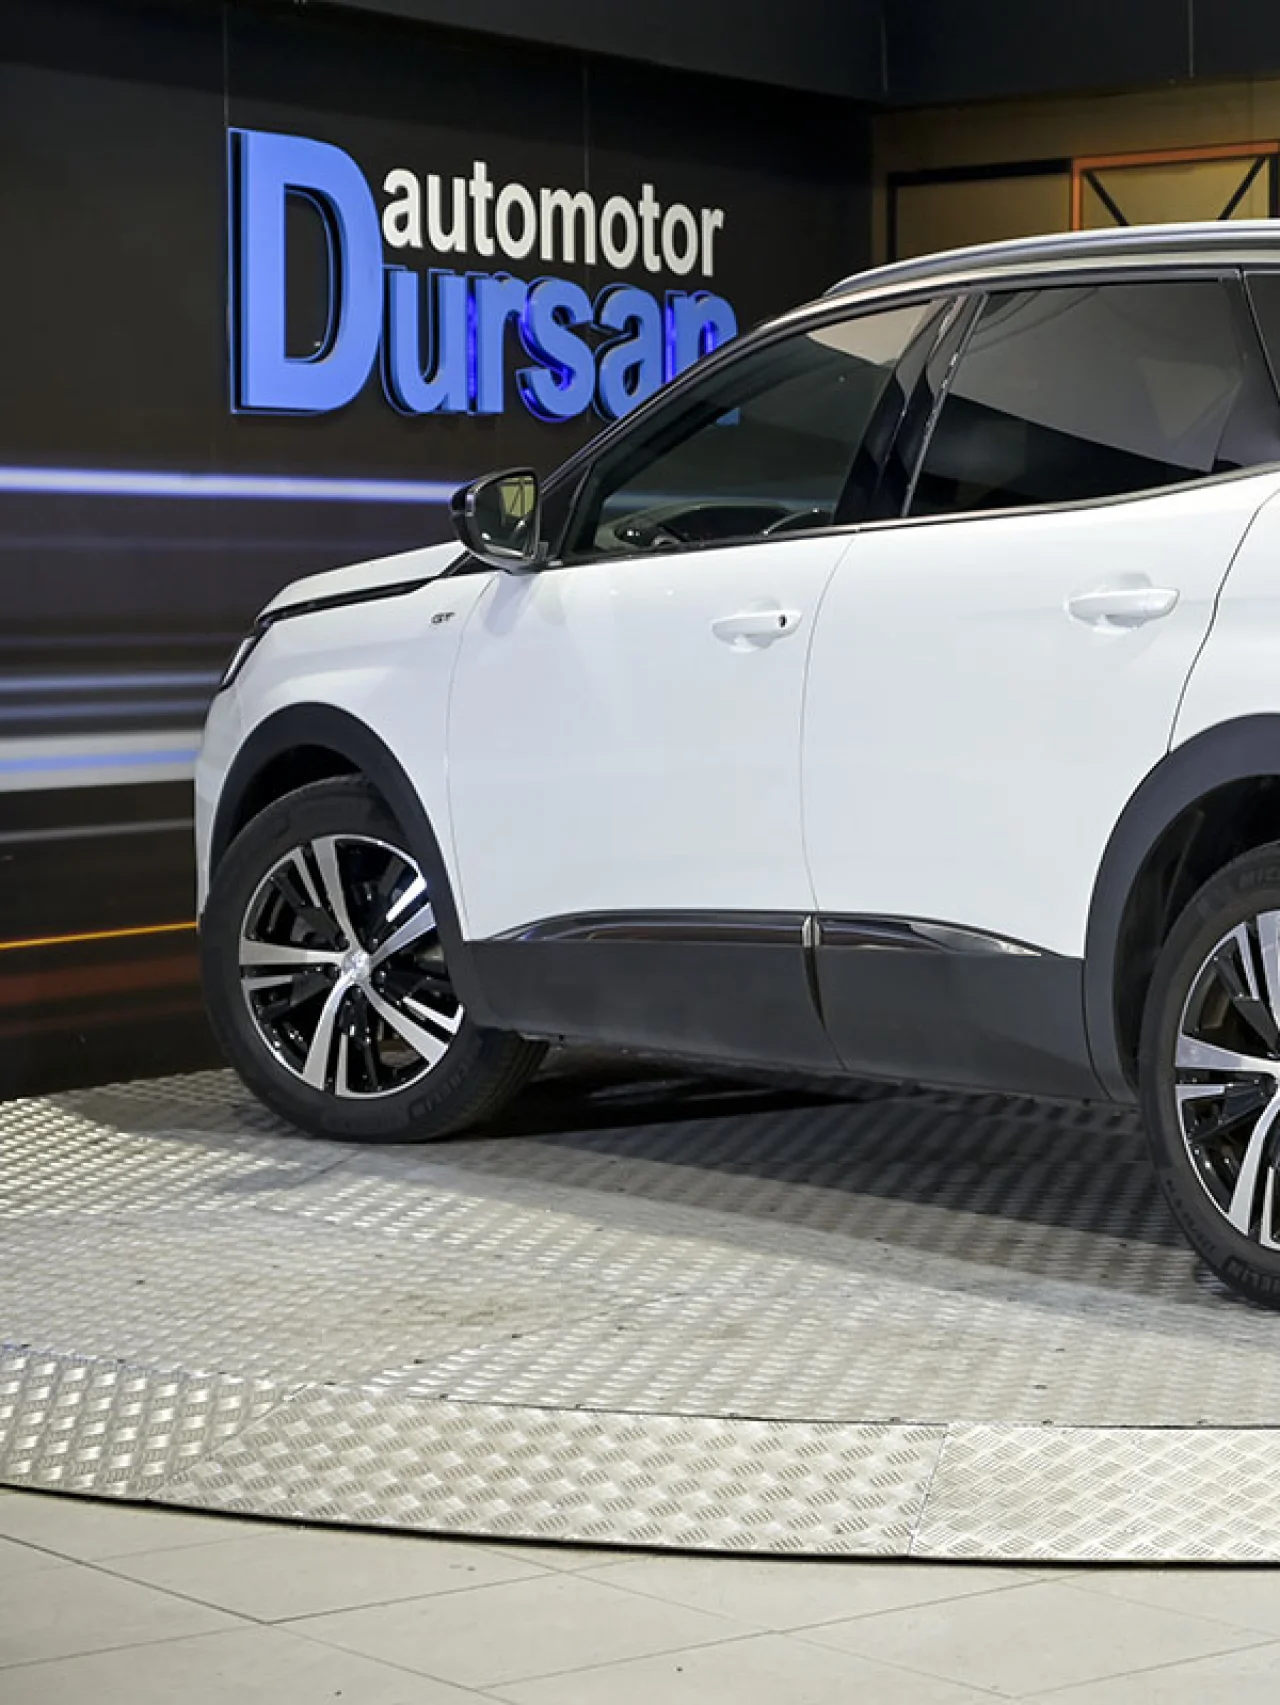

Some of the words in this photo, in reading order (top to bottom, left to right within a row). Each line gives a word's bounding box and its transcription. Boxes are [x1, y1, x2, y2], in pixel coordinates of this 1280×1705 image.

[228, 127, 740, 425] Dursan
[382, 161, 723, 277] automotor
[431, 611, 456, 624] GT
